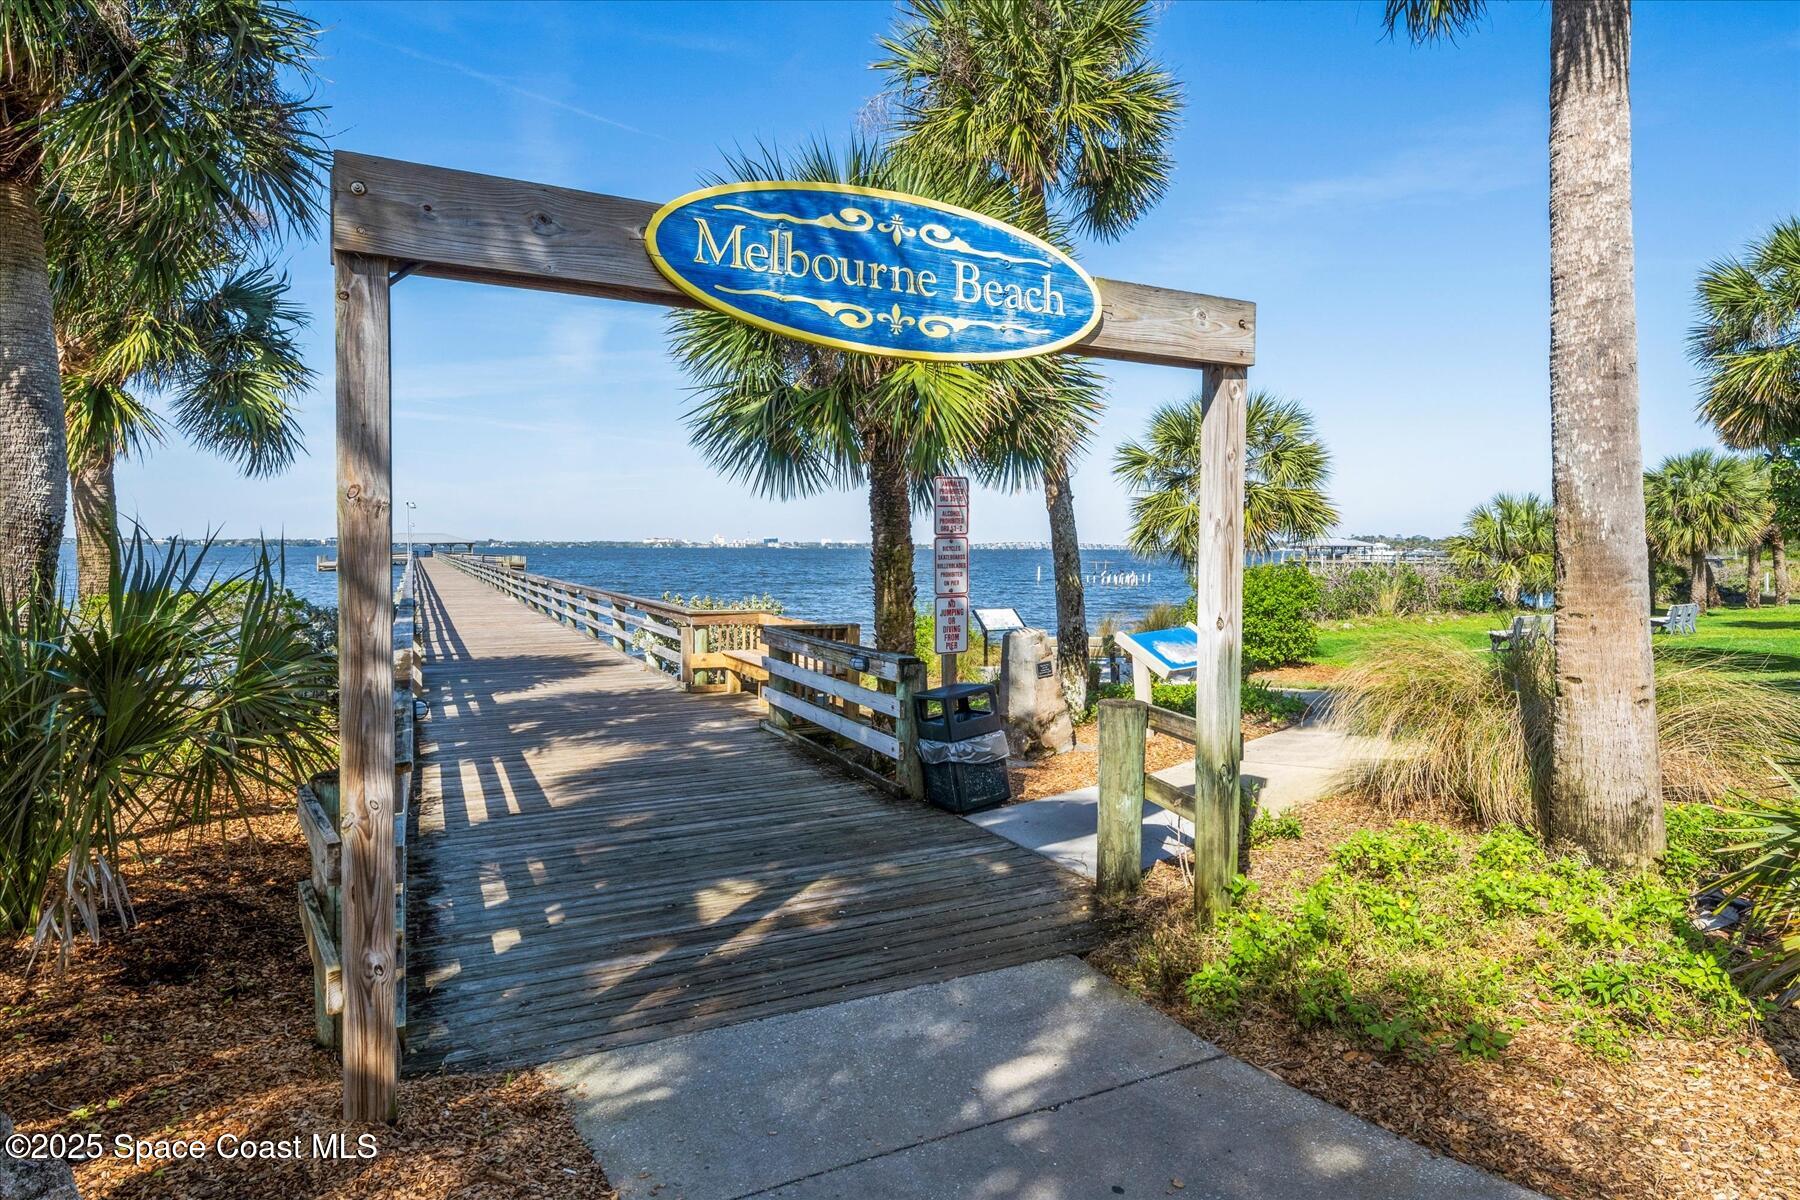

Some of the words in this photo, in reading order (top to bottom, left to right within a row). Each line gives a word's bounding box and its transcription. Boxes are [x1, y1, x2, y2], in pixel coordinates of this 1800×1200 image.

[694, 217, 939, 297] Melbourne
[952, 259, 1066, 317] Beach
[948, 600, 956, 608] NO
[940, 608, 964, 616] JUMPING
[943, 625, 961, 633] DIVING
[944, 633, 960, 641] FROM
[945, 642, 958, 650] PIER
